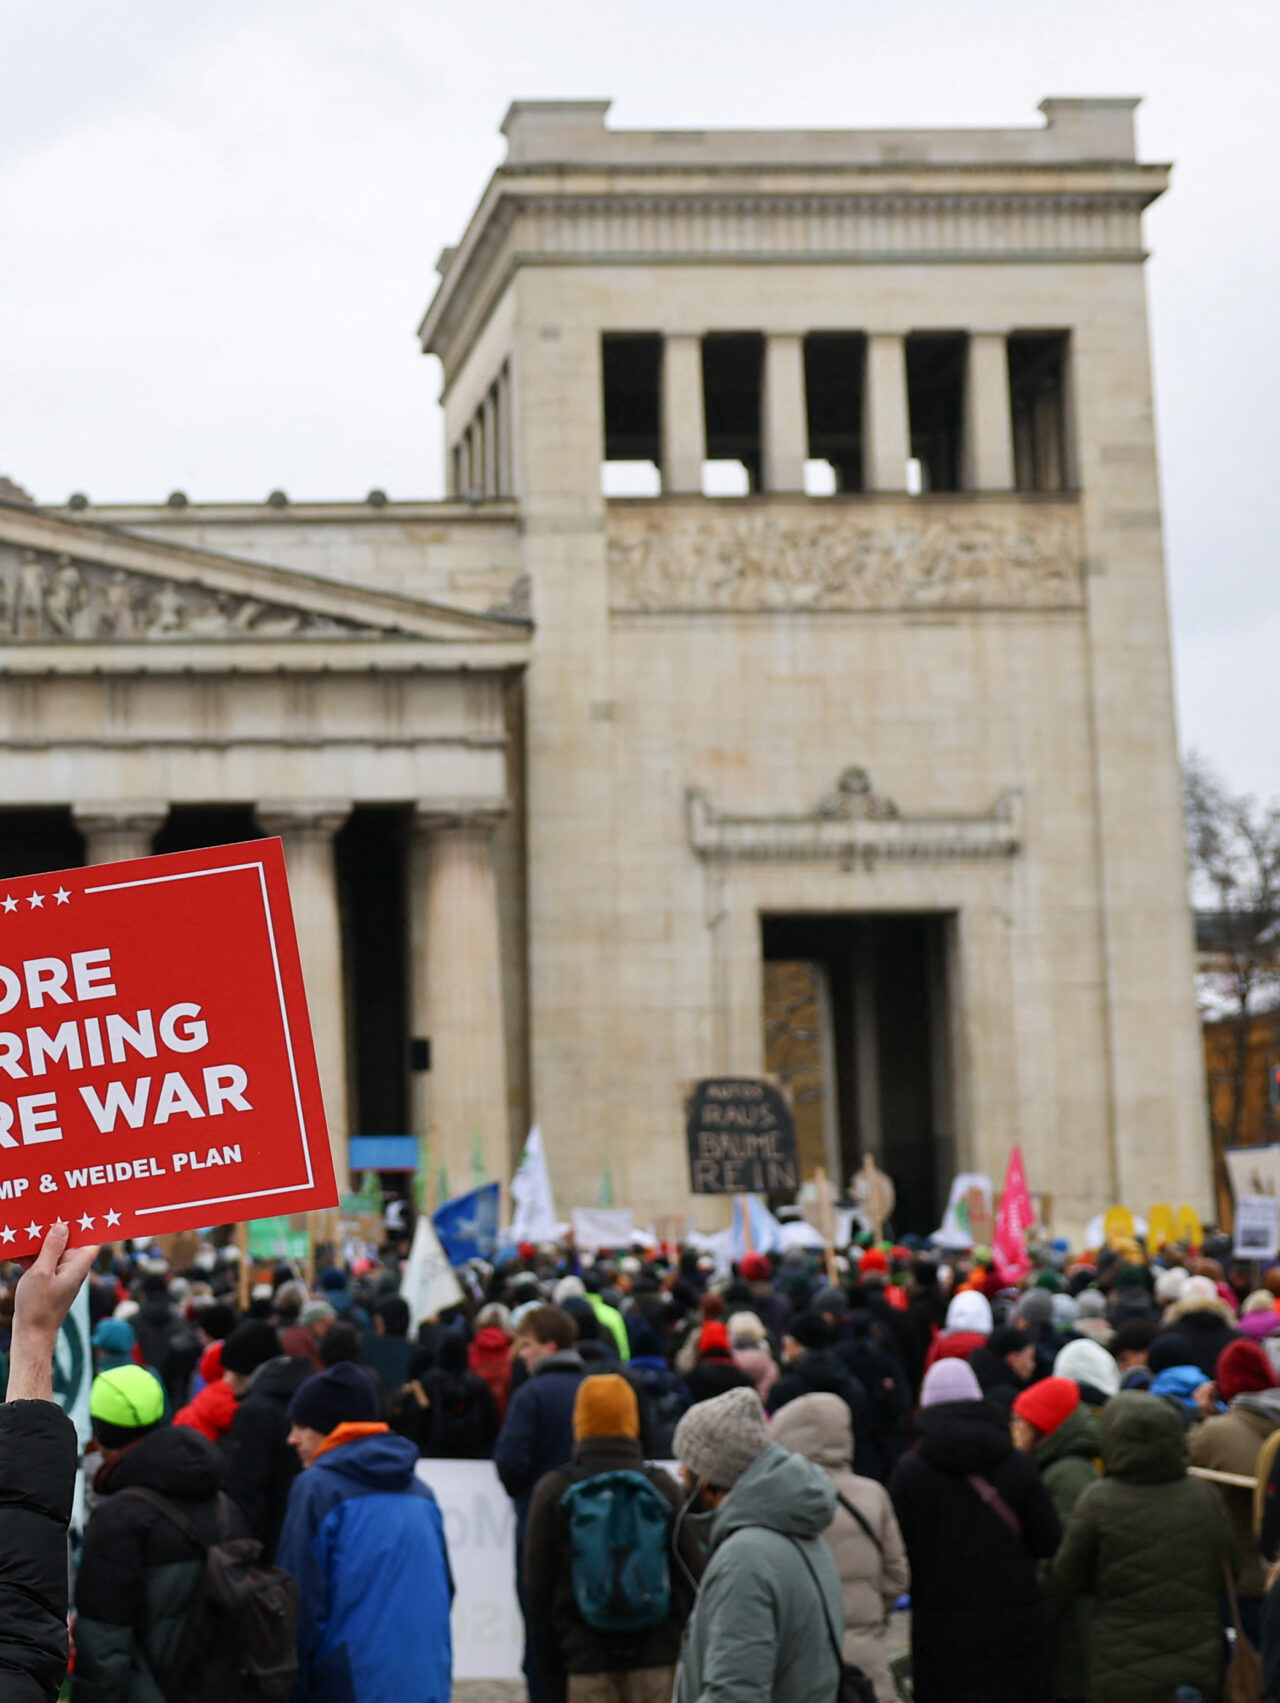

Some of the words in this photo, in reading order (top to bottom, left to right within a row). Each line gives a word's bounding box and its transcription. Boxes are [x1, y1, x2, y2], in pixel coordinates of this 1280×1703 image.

[78, 1064, 254, 1134] WAR
[701, 1103, 778, 1127] RAUS
[39, 1173, 58, 1193] &
[64, 1157, 166, 1189] WEIDEL
[172, 1144, 242, 1173] PLAN
[693, 1159, 797, 1191] REIN
